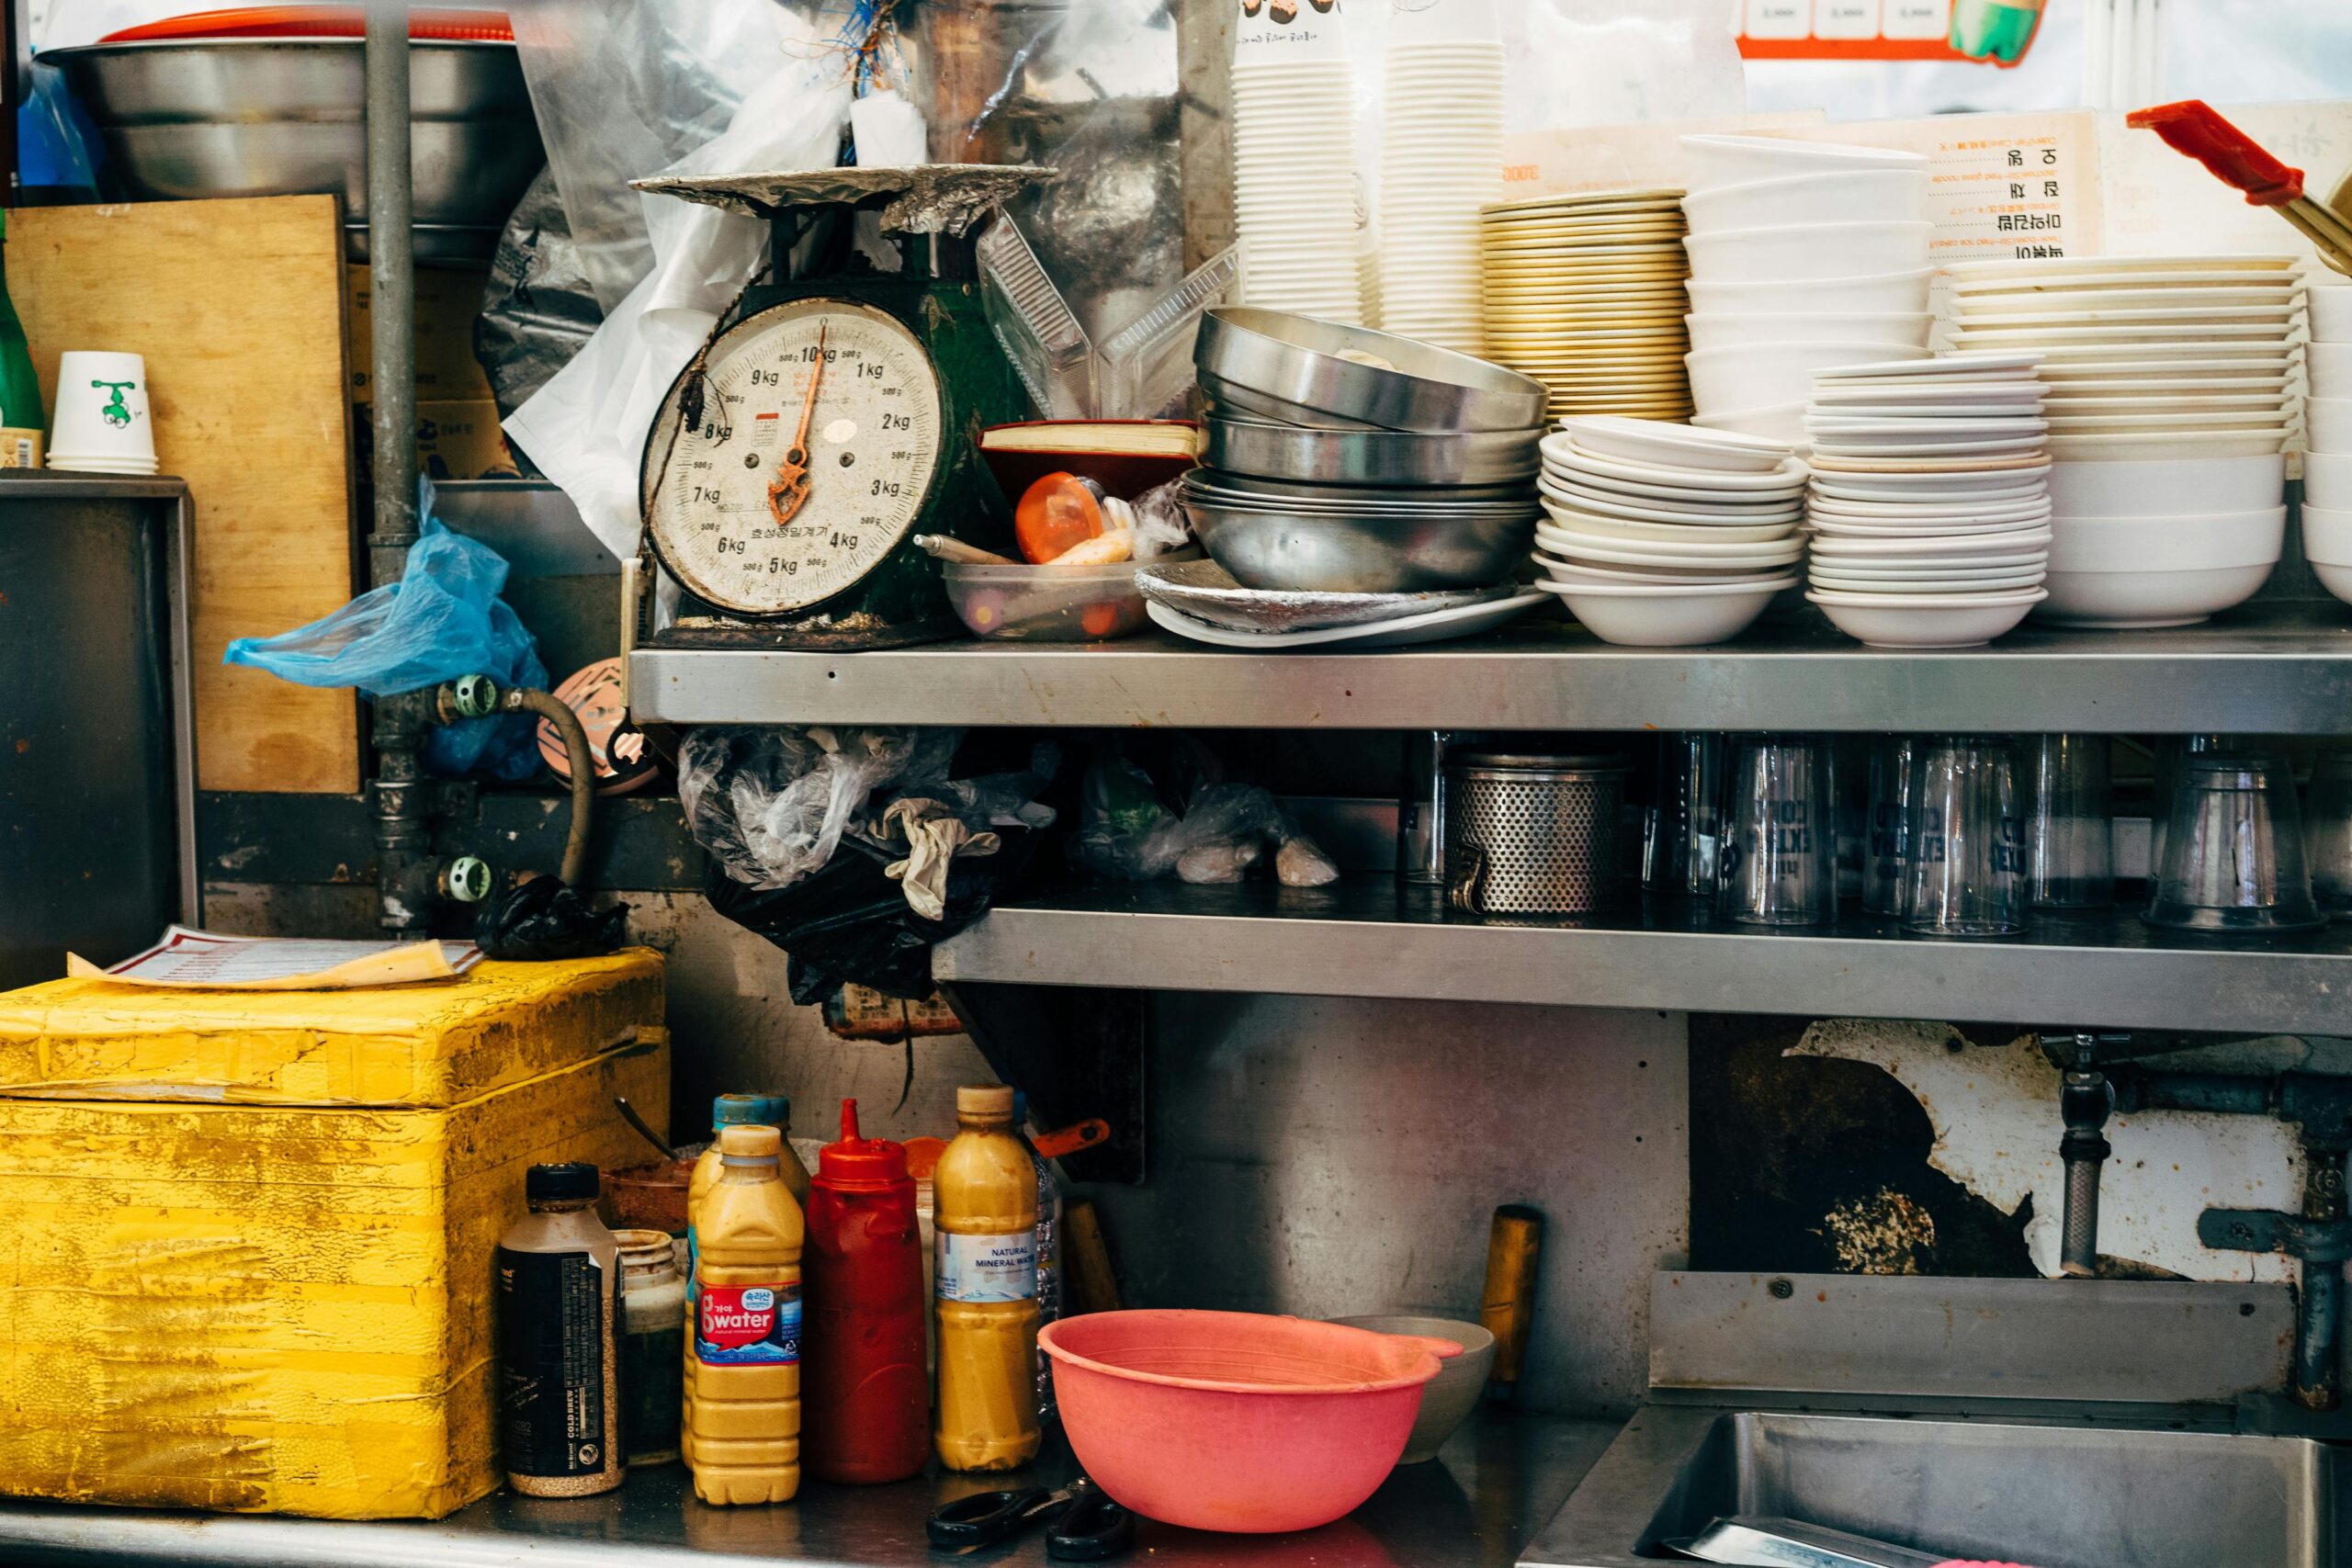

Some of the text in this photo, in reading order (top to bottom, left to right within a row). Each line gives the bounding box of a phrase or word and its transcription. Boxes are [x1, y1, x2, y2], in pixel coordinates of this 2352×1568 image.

[1996, 213, 2061, 231] 마약김밥
[991, 1246, 1029, 1258] NATURAL
[976, 1258, 1015, 1268] MINERAL
[714, 1304, 734, 1314] 가야
[714, 1312, 771, 1329] water
[566, 1390, 574, 1414] BREW
[567, 1415, 575, 1439] COLD
